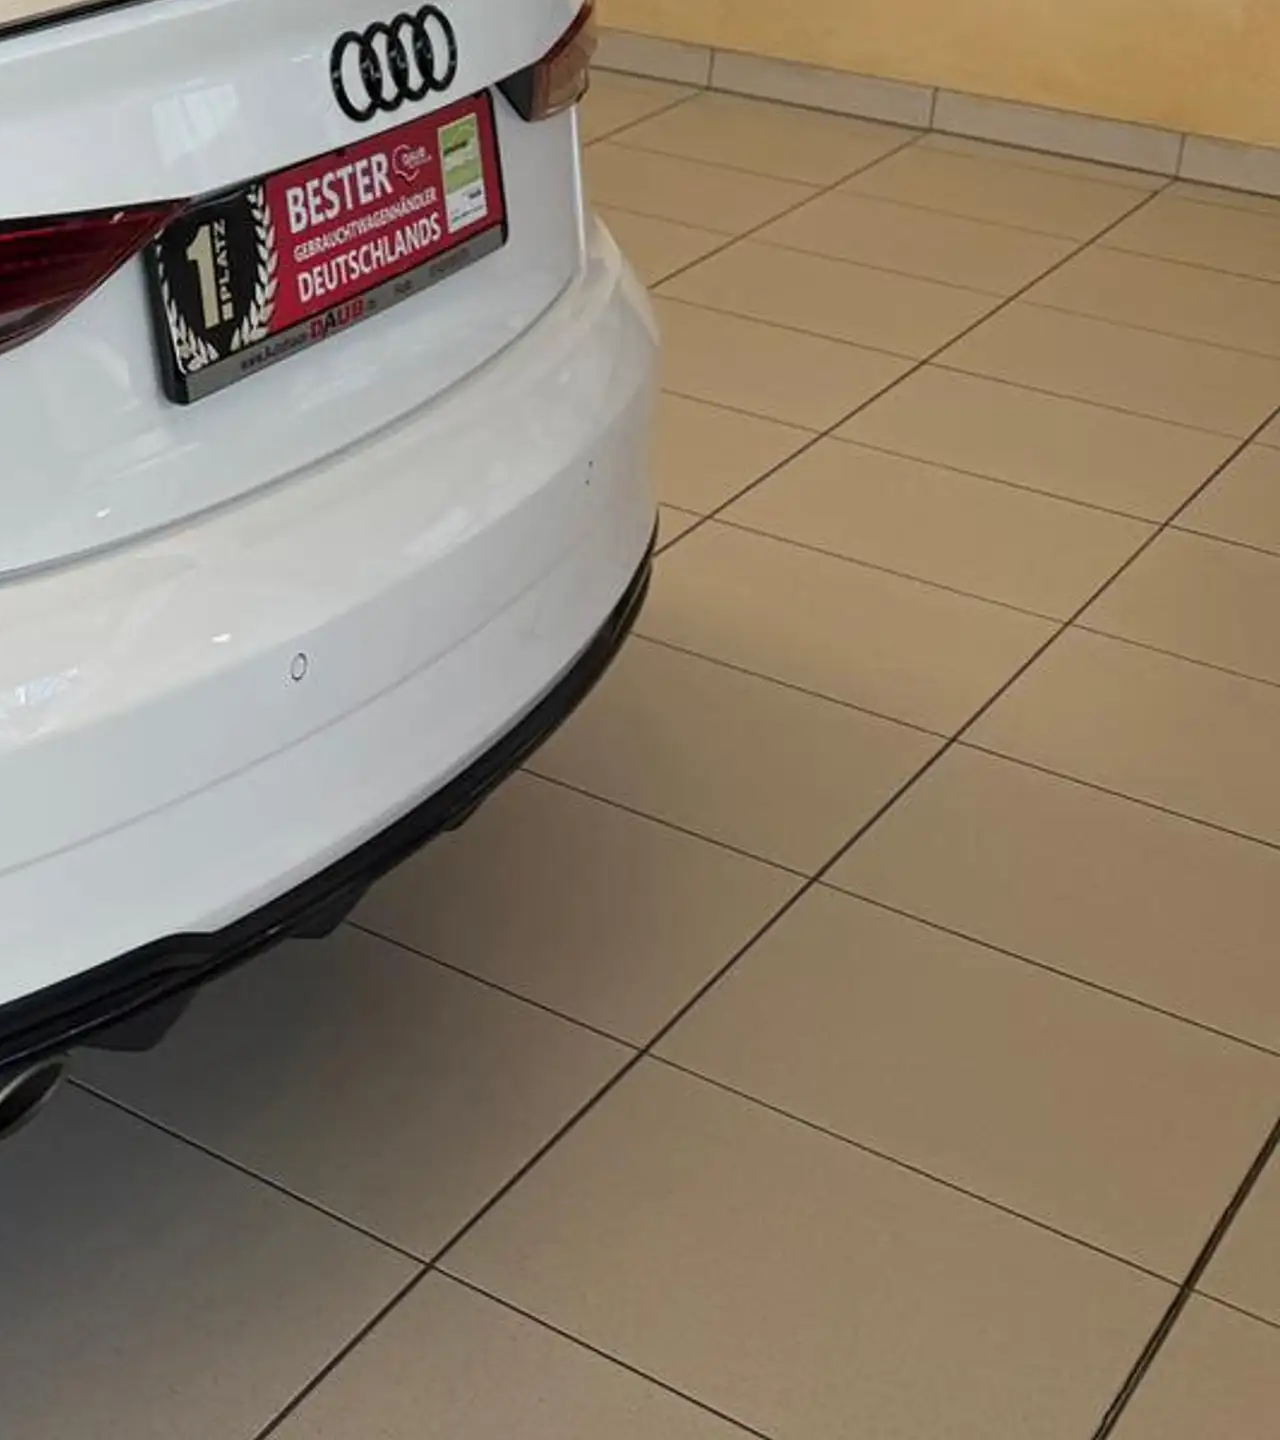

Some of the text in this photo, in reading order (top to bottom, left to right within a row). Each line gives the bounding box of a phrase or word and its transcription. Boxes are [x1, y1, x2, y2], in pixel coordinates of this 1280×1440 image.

[285, 153, 394, 234] BESTER
[293, 186, 437, 262] GEBRAUCHTWAGENHÄNDLER
[297, 212, 442, 303] DEUTSCHLANDS
